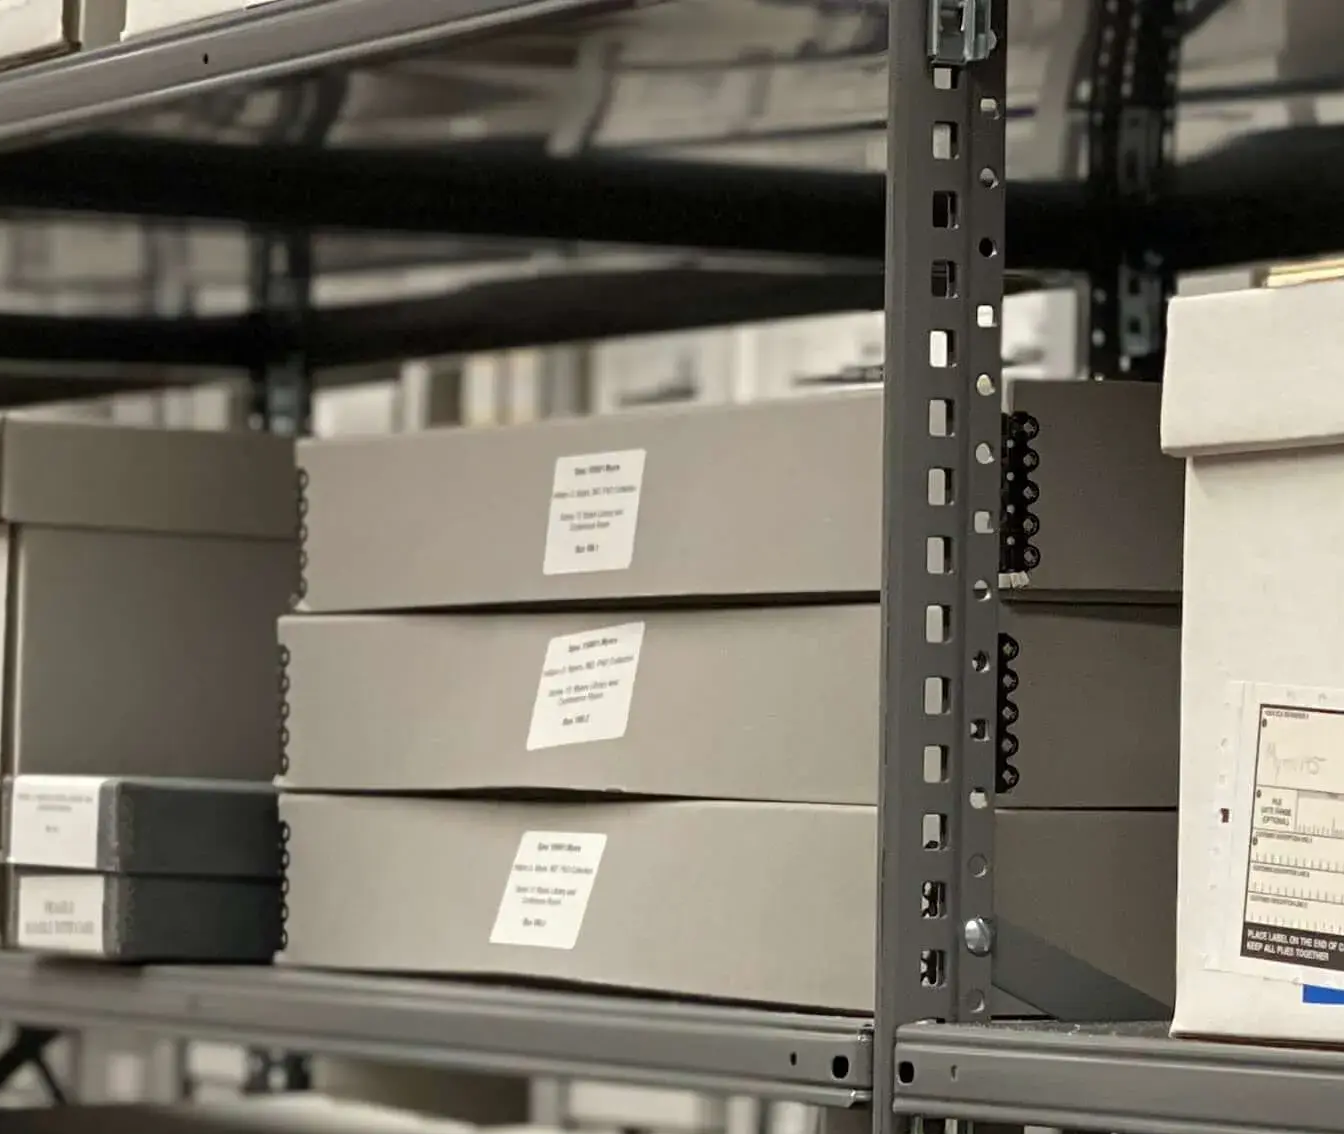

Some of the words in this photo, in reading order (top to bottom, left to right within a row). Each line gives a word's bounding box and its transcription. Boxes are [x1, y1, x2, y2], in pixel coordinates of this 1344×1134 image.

[1248, 929, 1267, 940] PLACE
[1268, 930, 1288, 943] LABEL
[1289, 935, 1299, 945] ON
[1300, 936, 1313, 947] THE
[1313, 938, 1327, 949] END
[1328, 941, 1336, 950] OF
[1246, 941, 1263, 951] KEEP
[1264, 943, 1276, 954] ALL
[1276, 945, 1294, 956] PLIES
[1296, 948, 1329, 961] TOGETHER
